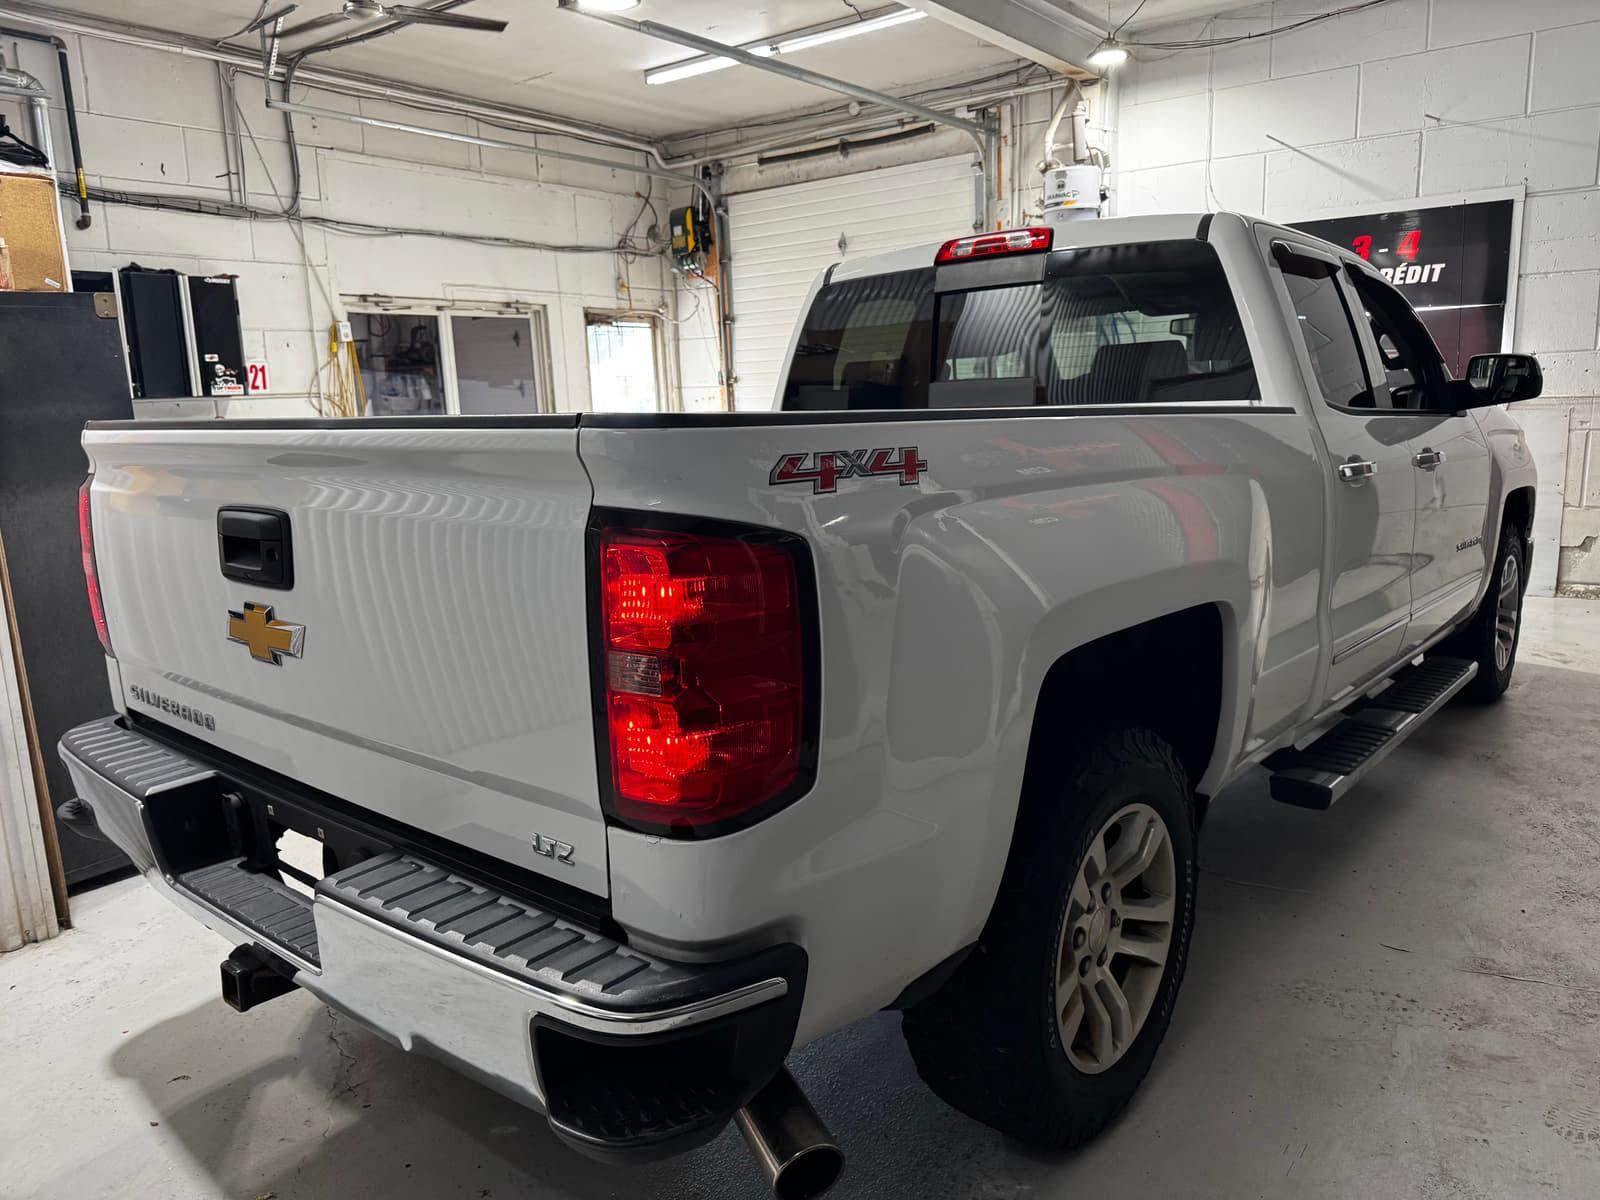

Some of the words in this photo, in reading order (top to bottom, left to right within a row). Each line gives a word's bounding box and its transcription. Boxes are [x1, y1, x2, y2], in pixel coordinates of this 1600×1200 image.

[1352, 235, 1373, 261] 3
[1396, 229, 1422, 262] 4
[1380, 262, 1446, 285] RÉDIT
[130, 684, 216, 732] SILVERADO
[531, 832, 576, 867] LTZ
